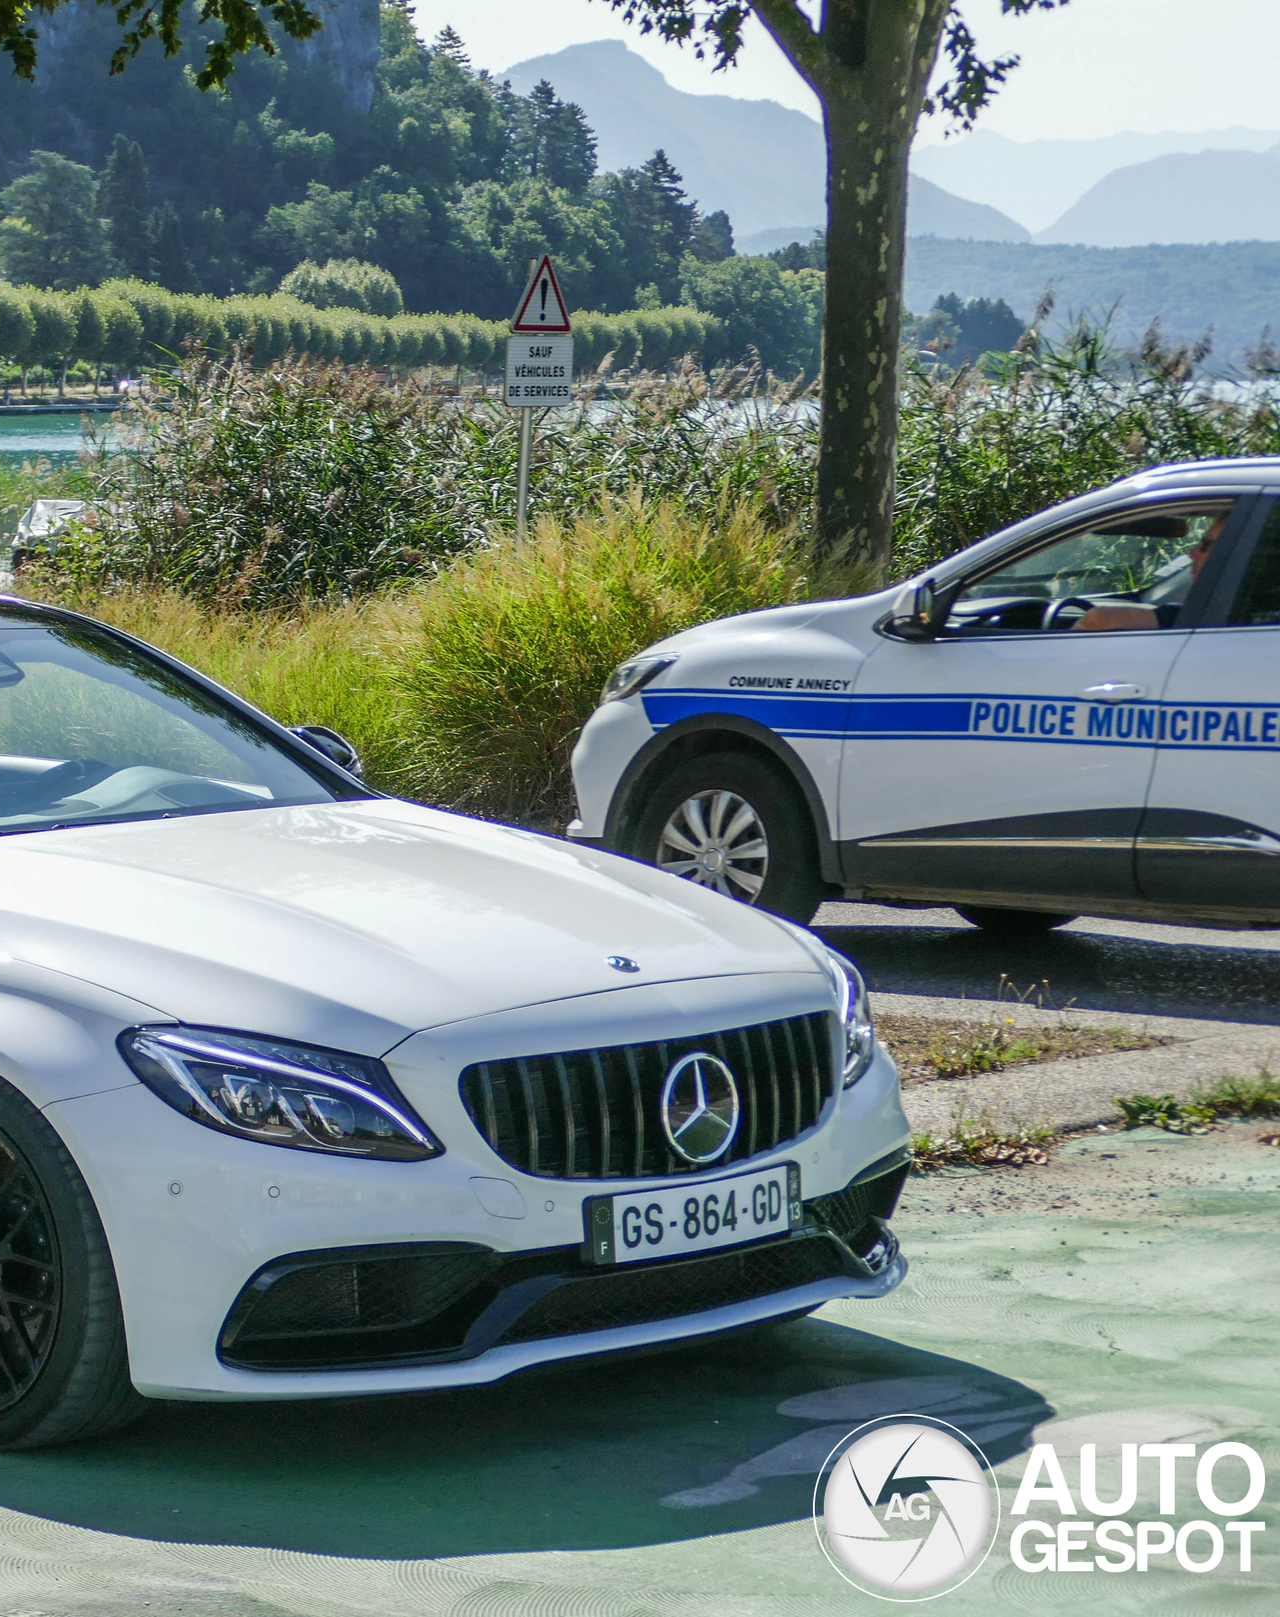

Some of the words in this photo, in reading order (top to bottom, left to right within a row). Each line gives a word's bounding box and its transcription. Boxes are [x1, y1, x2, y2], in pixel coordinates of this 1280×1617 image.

[529, 346, 553, 358] SAUF
[515, 364, 565, 378] VÉHICULES
[509, 385, 521, 397] DE
[524, 385, 569, 397] SERVICES
[729, 676, 793, 689] COMMUNE
[796, 678, 851, 691] ANNECY
[973, 702, 1076, 735] POLICE
[1087, 706, 1278, 743] MUNICIPALE
[622, 1180, 782, 1248] GS-864-GD
[789, 1201, 801, 1220] 13
[601, 1242, 608, 1255] F
